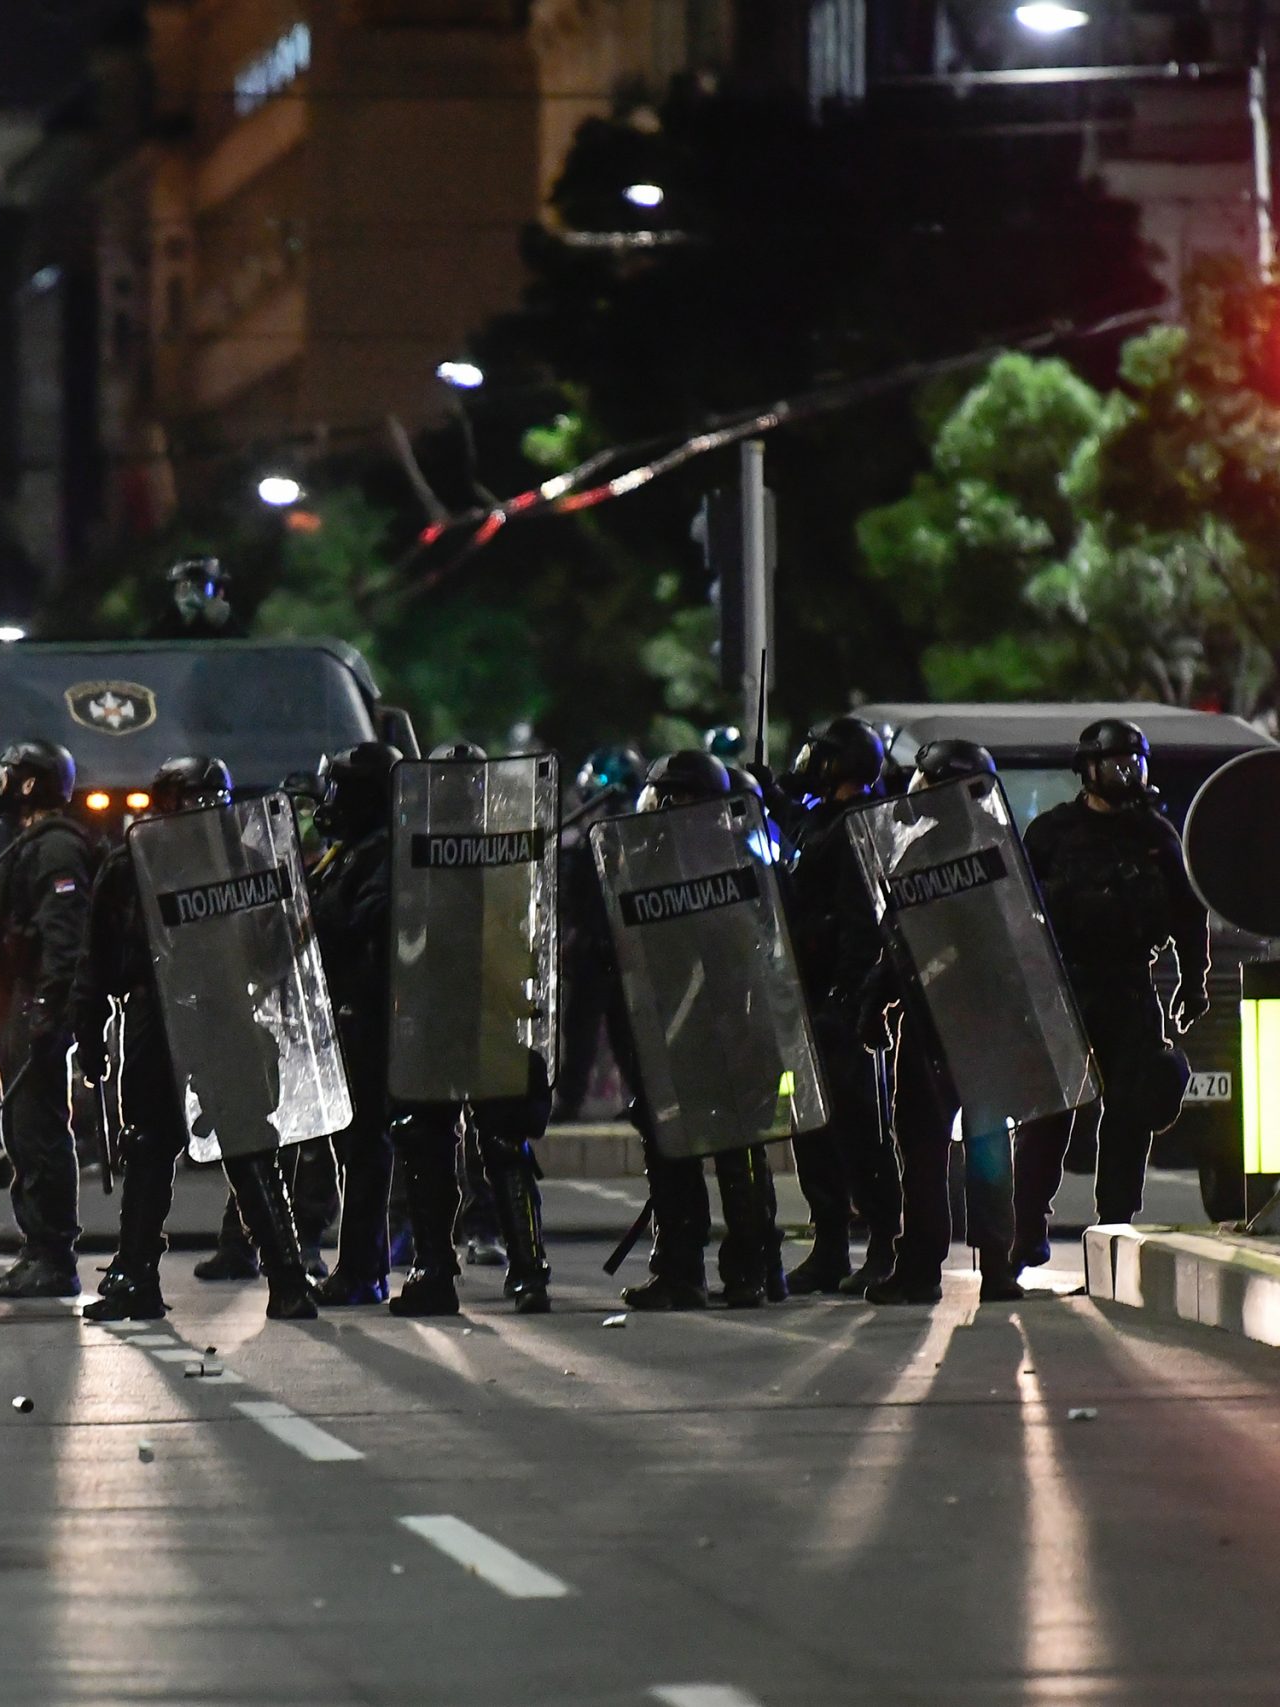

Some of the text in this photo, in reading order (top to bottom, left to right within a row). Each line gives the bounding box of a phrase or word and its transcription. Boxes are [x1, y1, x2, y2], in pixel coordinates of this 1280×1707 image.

[431, 834, 530, 865] ПОЛИЦИЈА
[177, 873, 279, 920] ПОЛИЦИЈА
[634, 876, 740, 920] ПОЛИЦИЈА
[891, 857, 988, 909] ПОЛИЦИЈА
